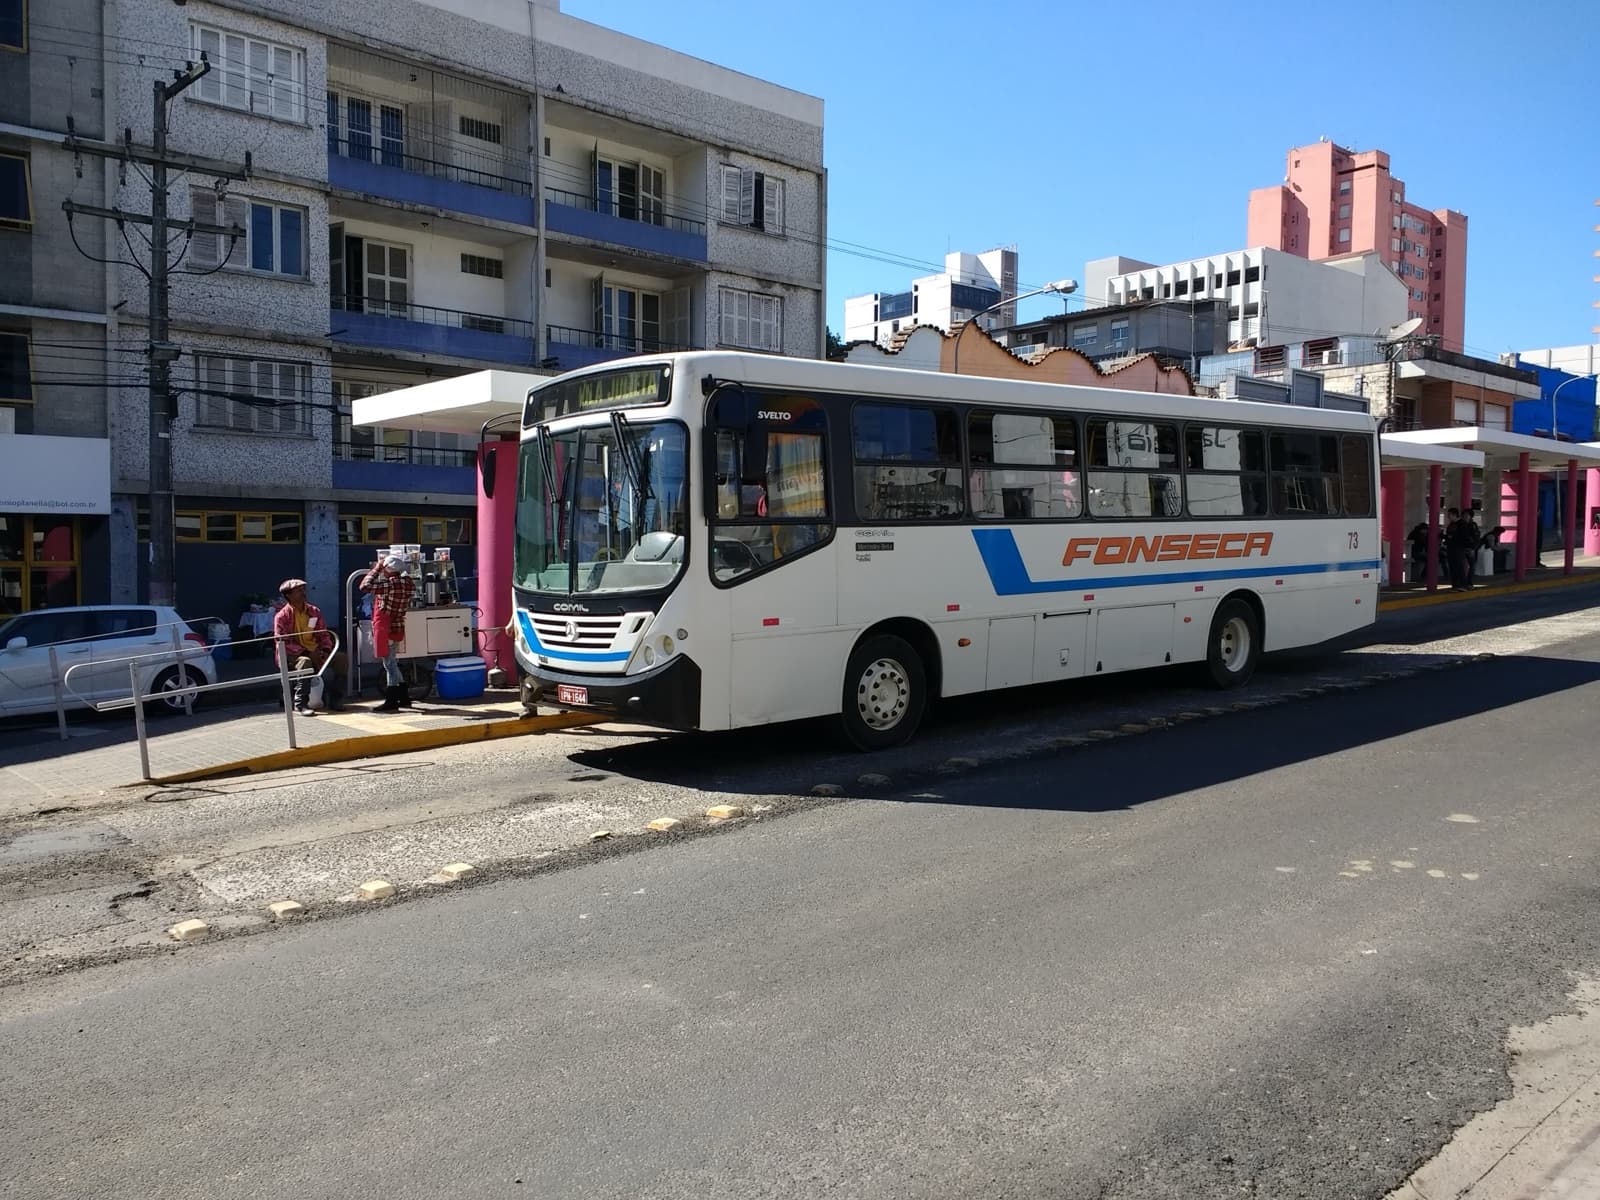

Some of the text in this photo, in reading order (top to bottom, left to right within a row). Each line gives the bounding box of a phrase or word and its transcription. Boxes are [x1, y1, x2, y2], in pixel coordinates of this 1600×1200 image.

[757, 410, 792, 420] SVELTO
[1347, 532, 1359, 549] 73
[1062, 532, 1273, 566] FONSECA
[553, 602, 590, 612] COMIL
